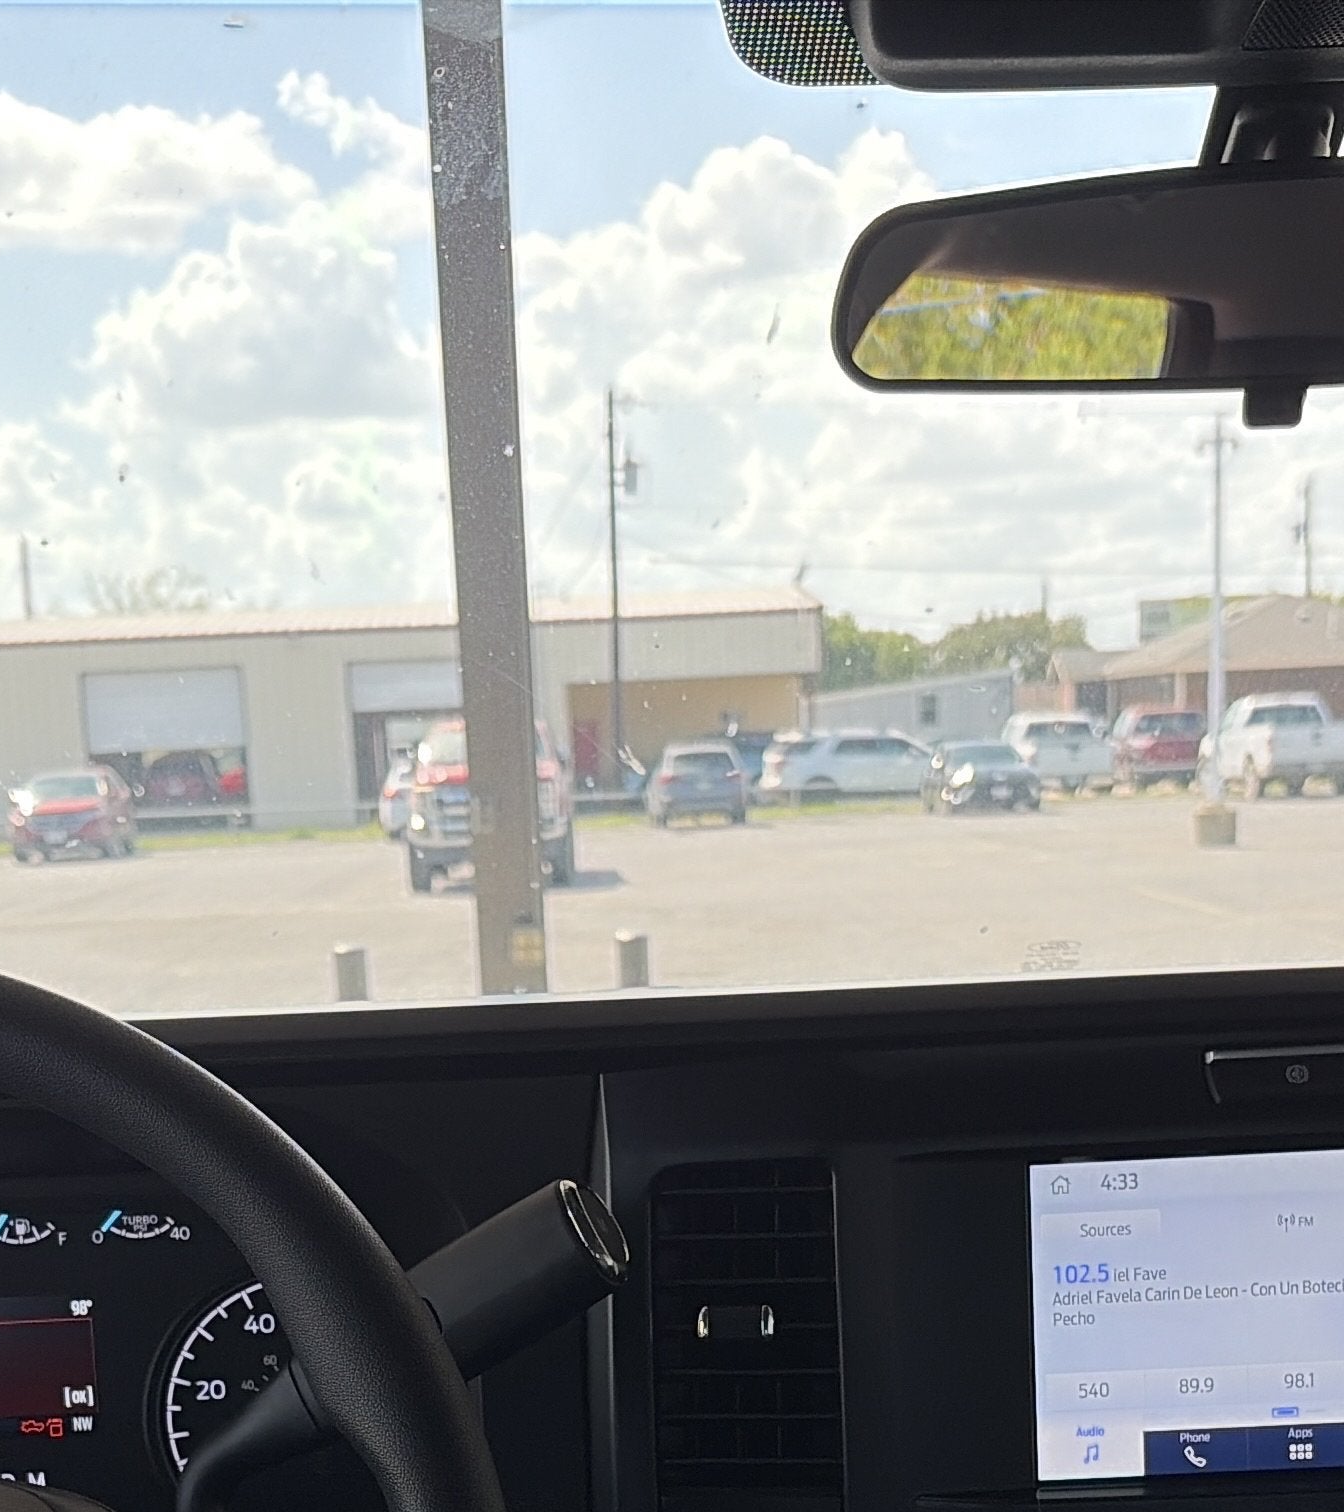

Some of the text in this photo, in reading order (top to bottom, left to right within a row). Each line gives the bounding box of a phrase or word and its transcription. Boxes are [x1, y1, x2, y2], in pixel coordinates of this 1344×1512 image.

[1100, 1173, 1139, 1191] 4:33
[121, 1215, 158, 1227] TURBO
[1298, 1216, 1314, 1227] FM
[169, 1226, 191, 1241] 40
[1079, 1223, 1132, 1238] Sources
[58, 1231, 67, 1246] F
[1053, 1263, 1167, 1284] 102.5 iel Fave
[1053, 1291, 1093, 1306] Adriel
[1096, 1289, 1142, 1304] Favela
[1144, 1286, 1180, 1301] Carin
[1183, 1285, 1202, 1300] De
[1205, 1284, 1239, 1299] Leon
[1250, 1282, 1277, 1297] Con
[1279, 1281, 1300, 1295] Un
[243, 1313, 276, 1334] 40
[1053, 1311, 1095, 1326] Pecho
[1179, 1377, 1214, 1394] 89.9
[1284, 1372, 1314, 1389] 98.1
[195, 1379, 227, 1401] 20
[1078, 1382, 1109, 1398] 540
[72, 1416, 93, 1432] NW
[1076, 1426, 1105, 1437] Audio
[1179, 1432, 1211, 1443] Phone
[1287, 1428, 1313, 1441] Apps
